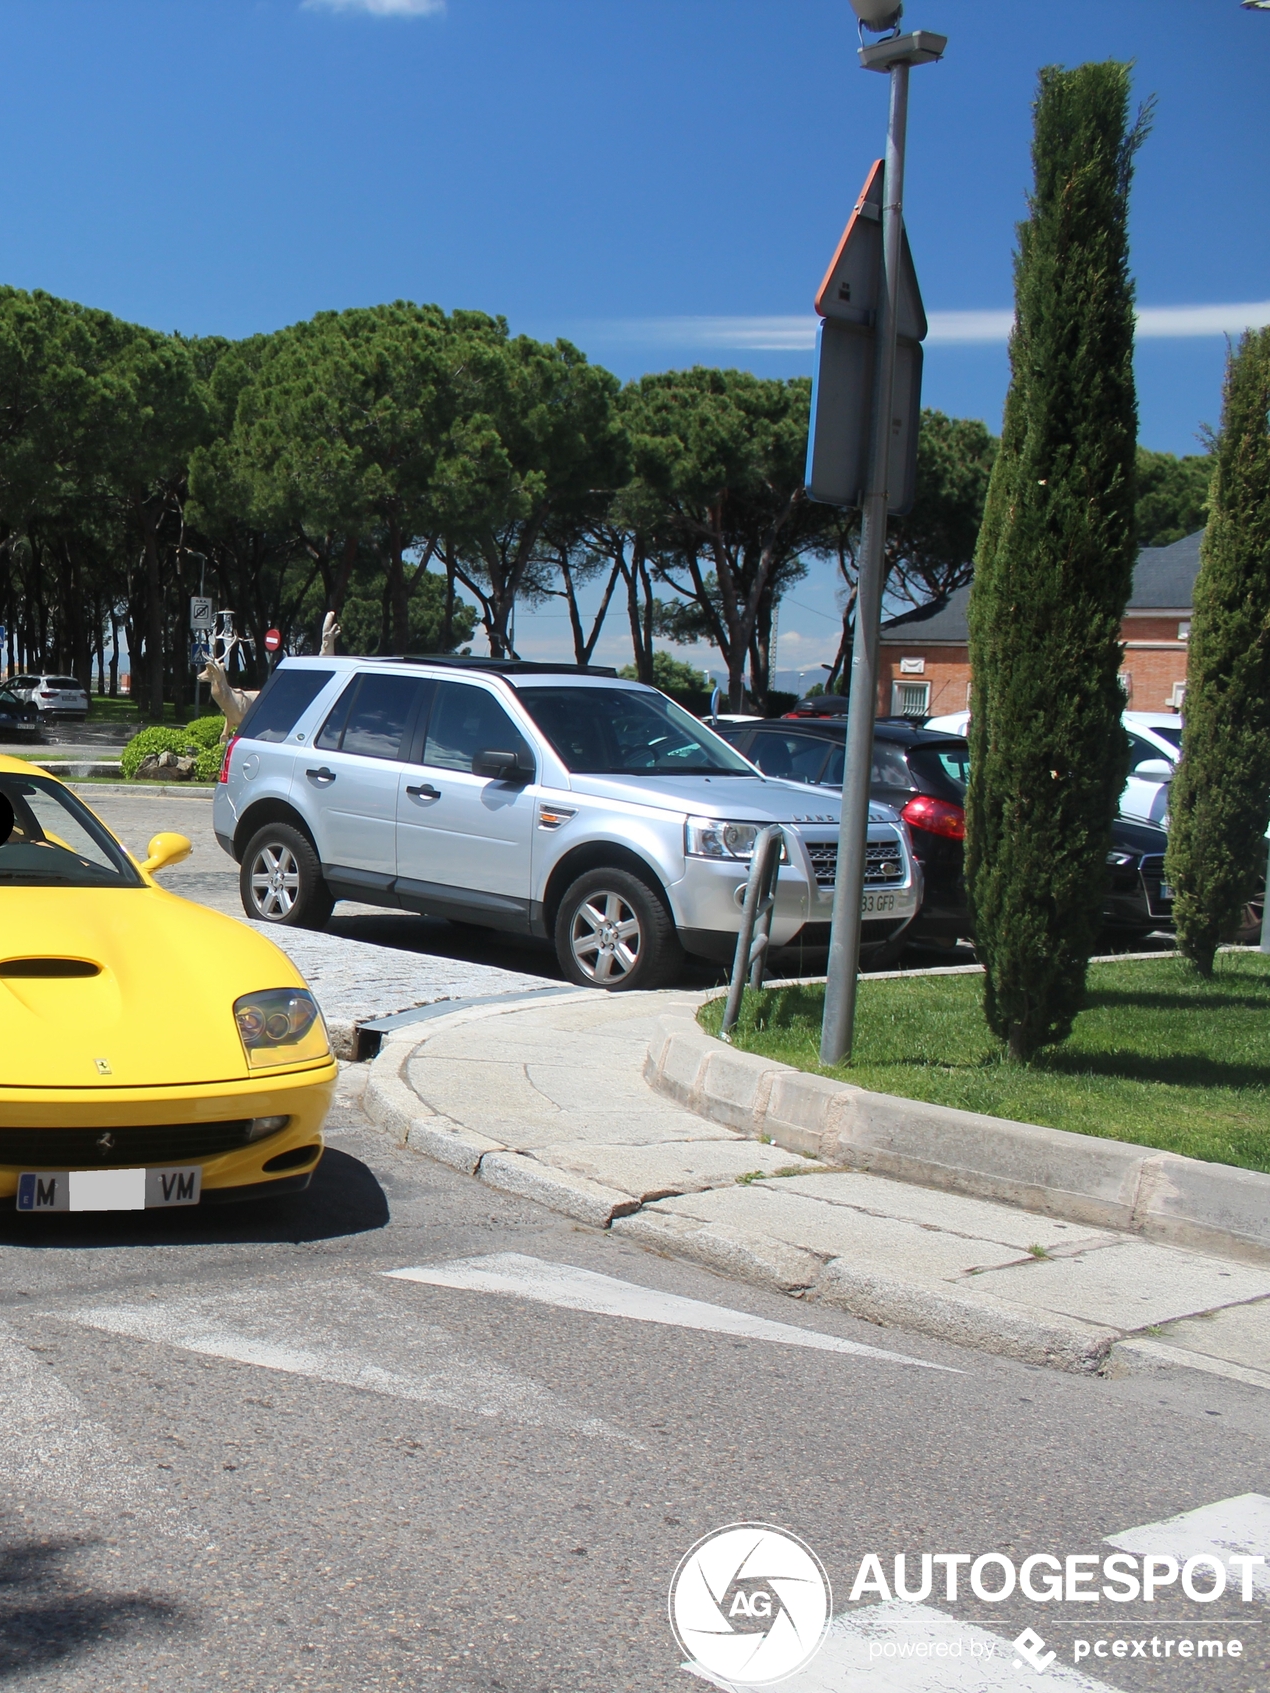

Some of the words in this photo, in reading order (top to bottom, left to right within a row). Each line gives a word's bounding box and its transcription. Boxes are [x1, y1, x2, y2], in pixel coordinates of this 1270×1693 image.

[861, 896, 874, 912] 33
[877, 895, 895, 912] GFB
[36, 1178, 55, 1206] M
[161, 1172, 195, 1201] VM
